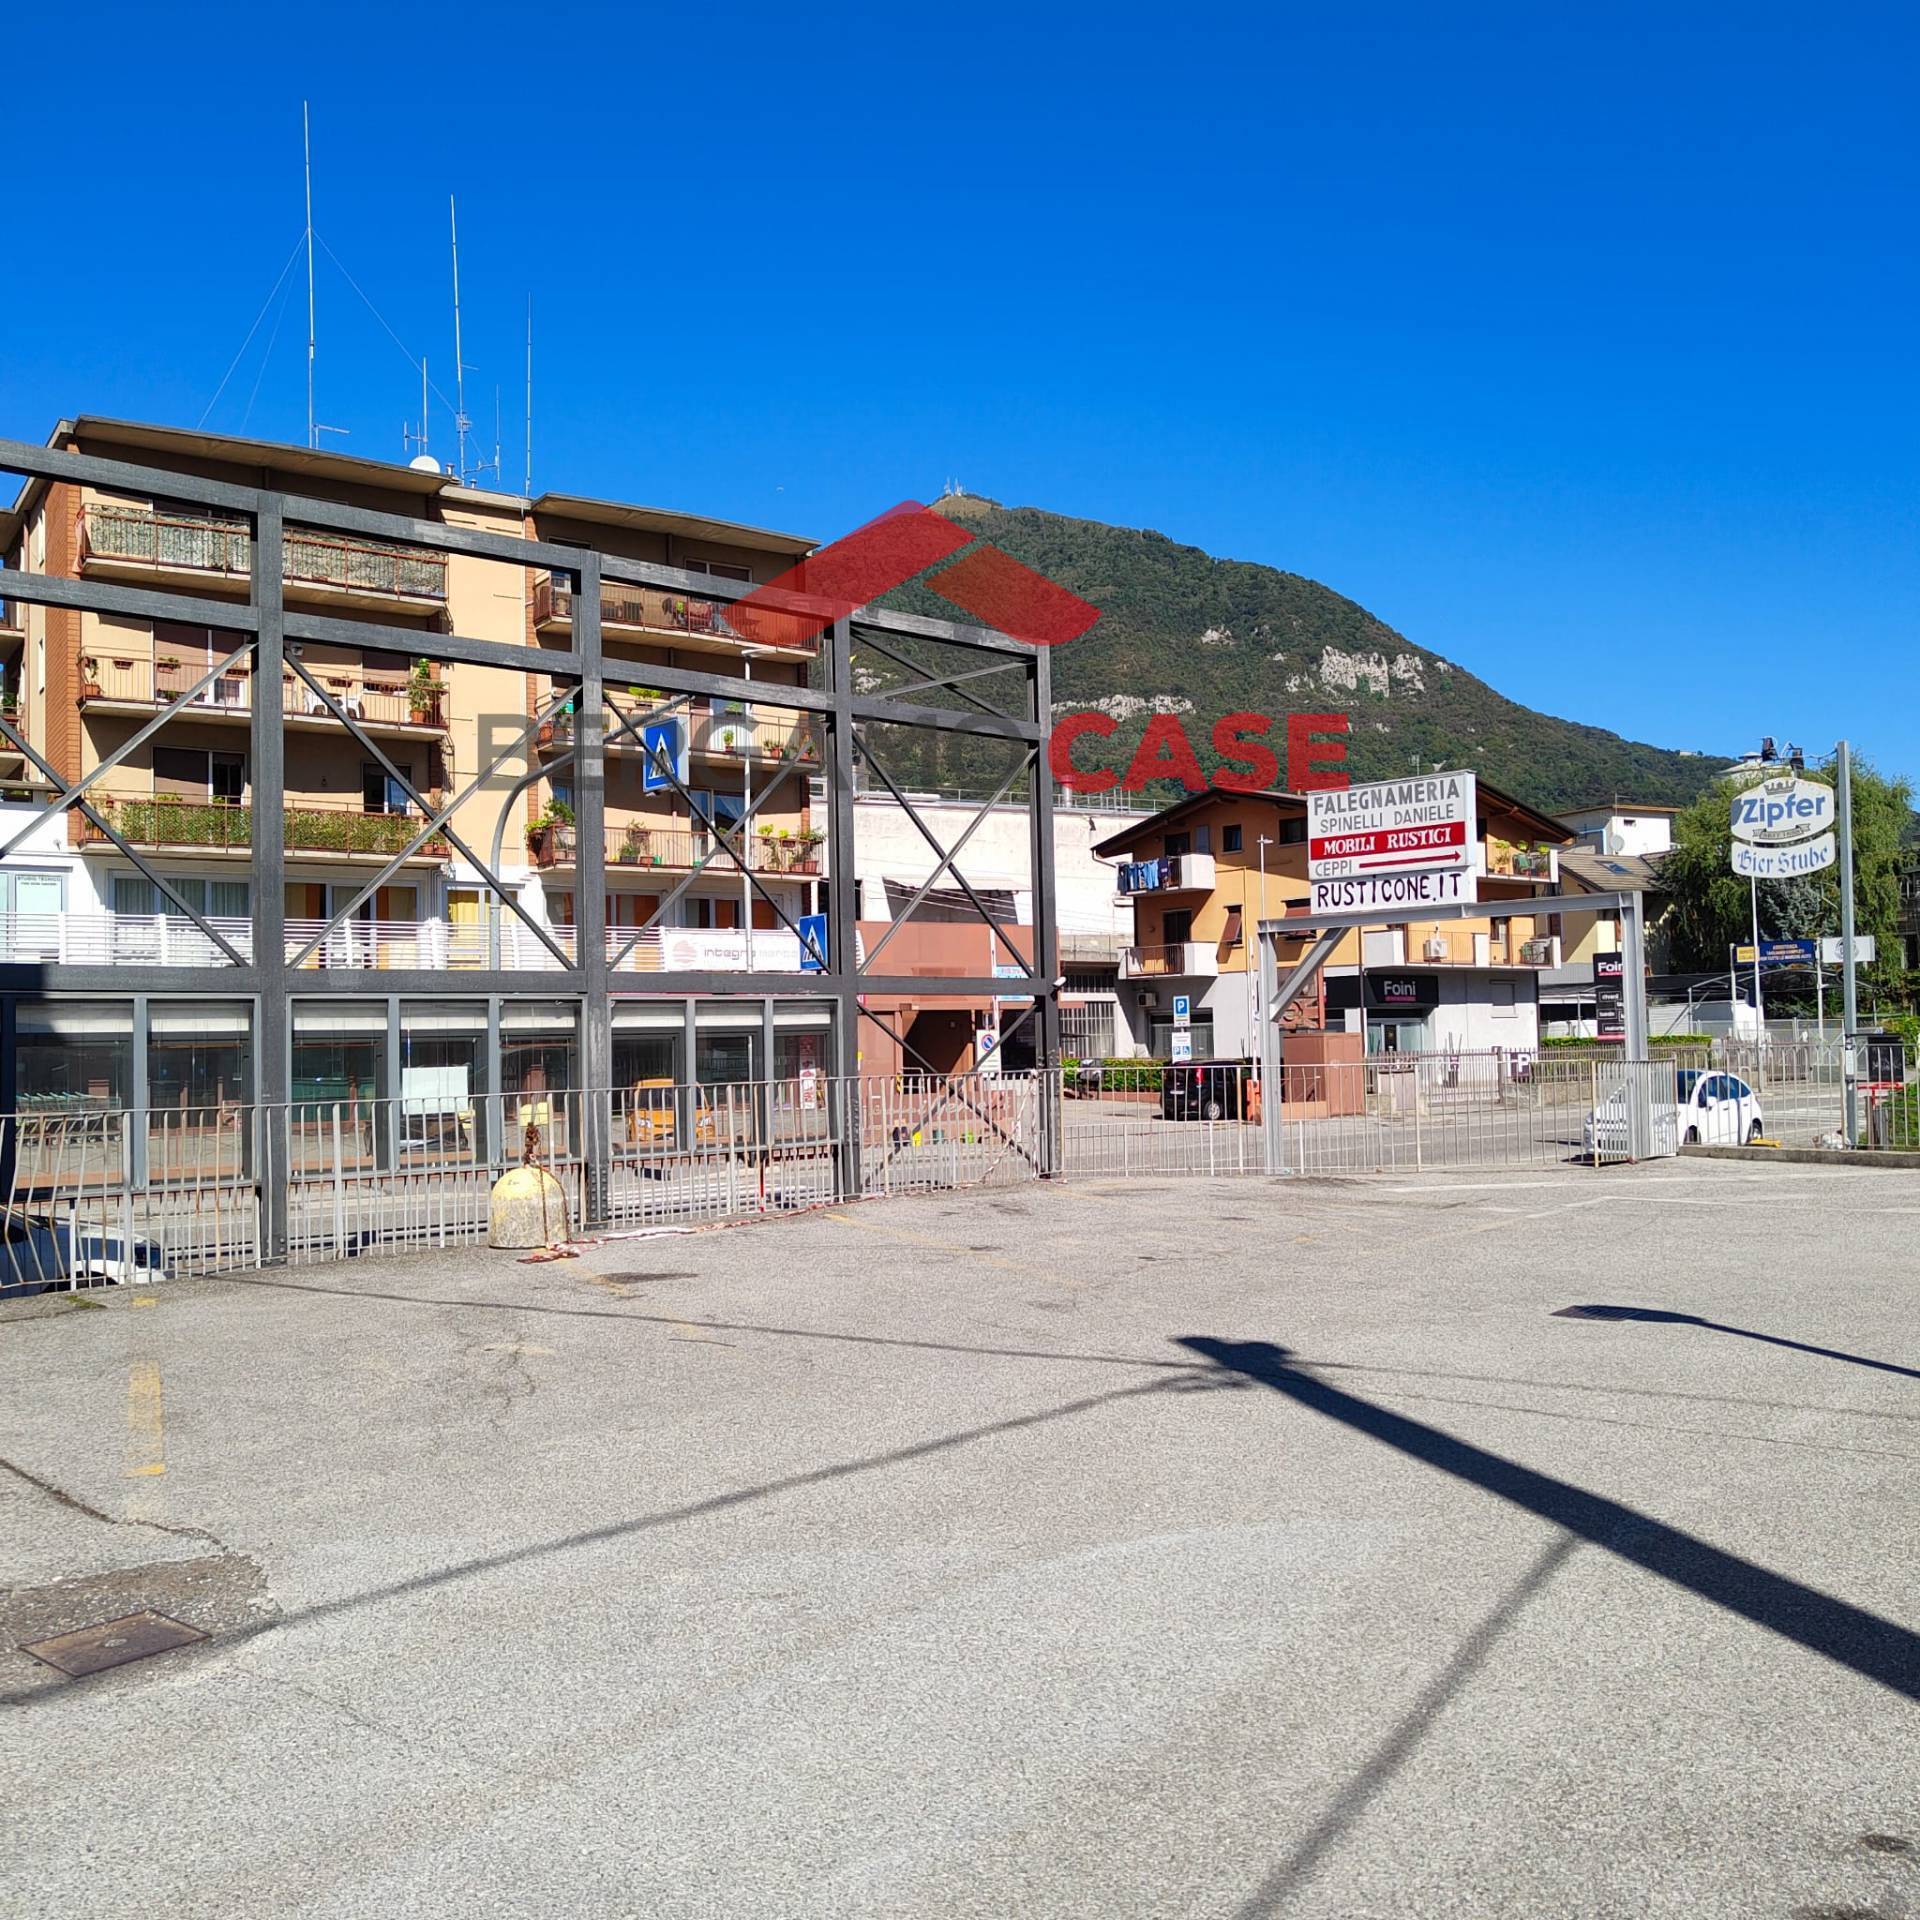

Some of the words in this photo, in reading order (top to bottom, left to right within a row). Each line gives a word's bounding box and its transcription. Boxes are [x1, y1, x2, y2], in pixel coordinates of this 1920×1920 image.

[1314, 779, 1460, 815] FALEGNAMERIA
[1742, 793, 1825, 827] Zipfer
[1320, 813, 1383, 833] SPINELLI
[1394, 804, 1454, 826] DANIELE
[1323, 836, 1375, 856] MOBILI
[1387, 828, 1452, 849] RUSTICI
[1315, 860, 1352, 877] CEPPI
[1737, 849, 1773, 873] Bier
[1778, 845, 1828, 874] Stube
[1317, 873, 1462, 908] RUSTICONE.IT
[1384, 980, 1417, 996] Foini
[1177, 1001, 1185, 1012] P
